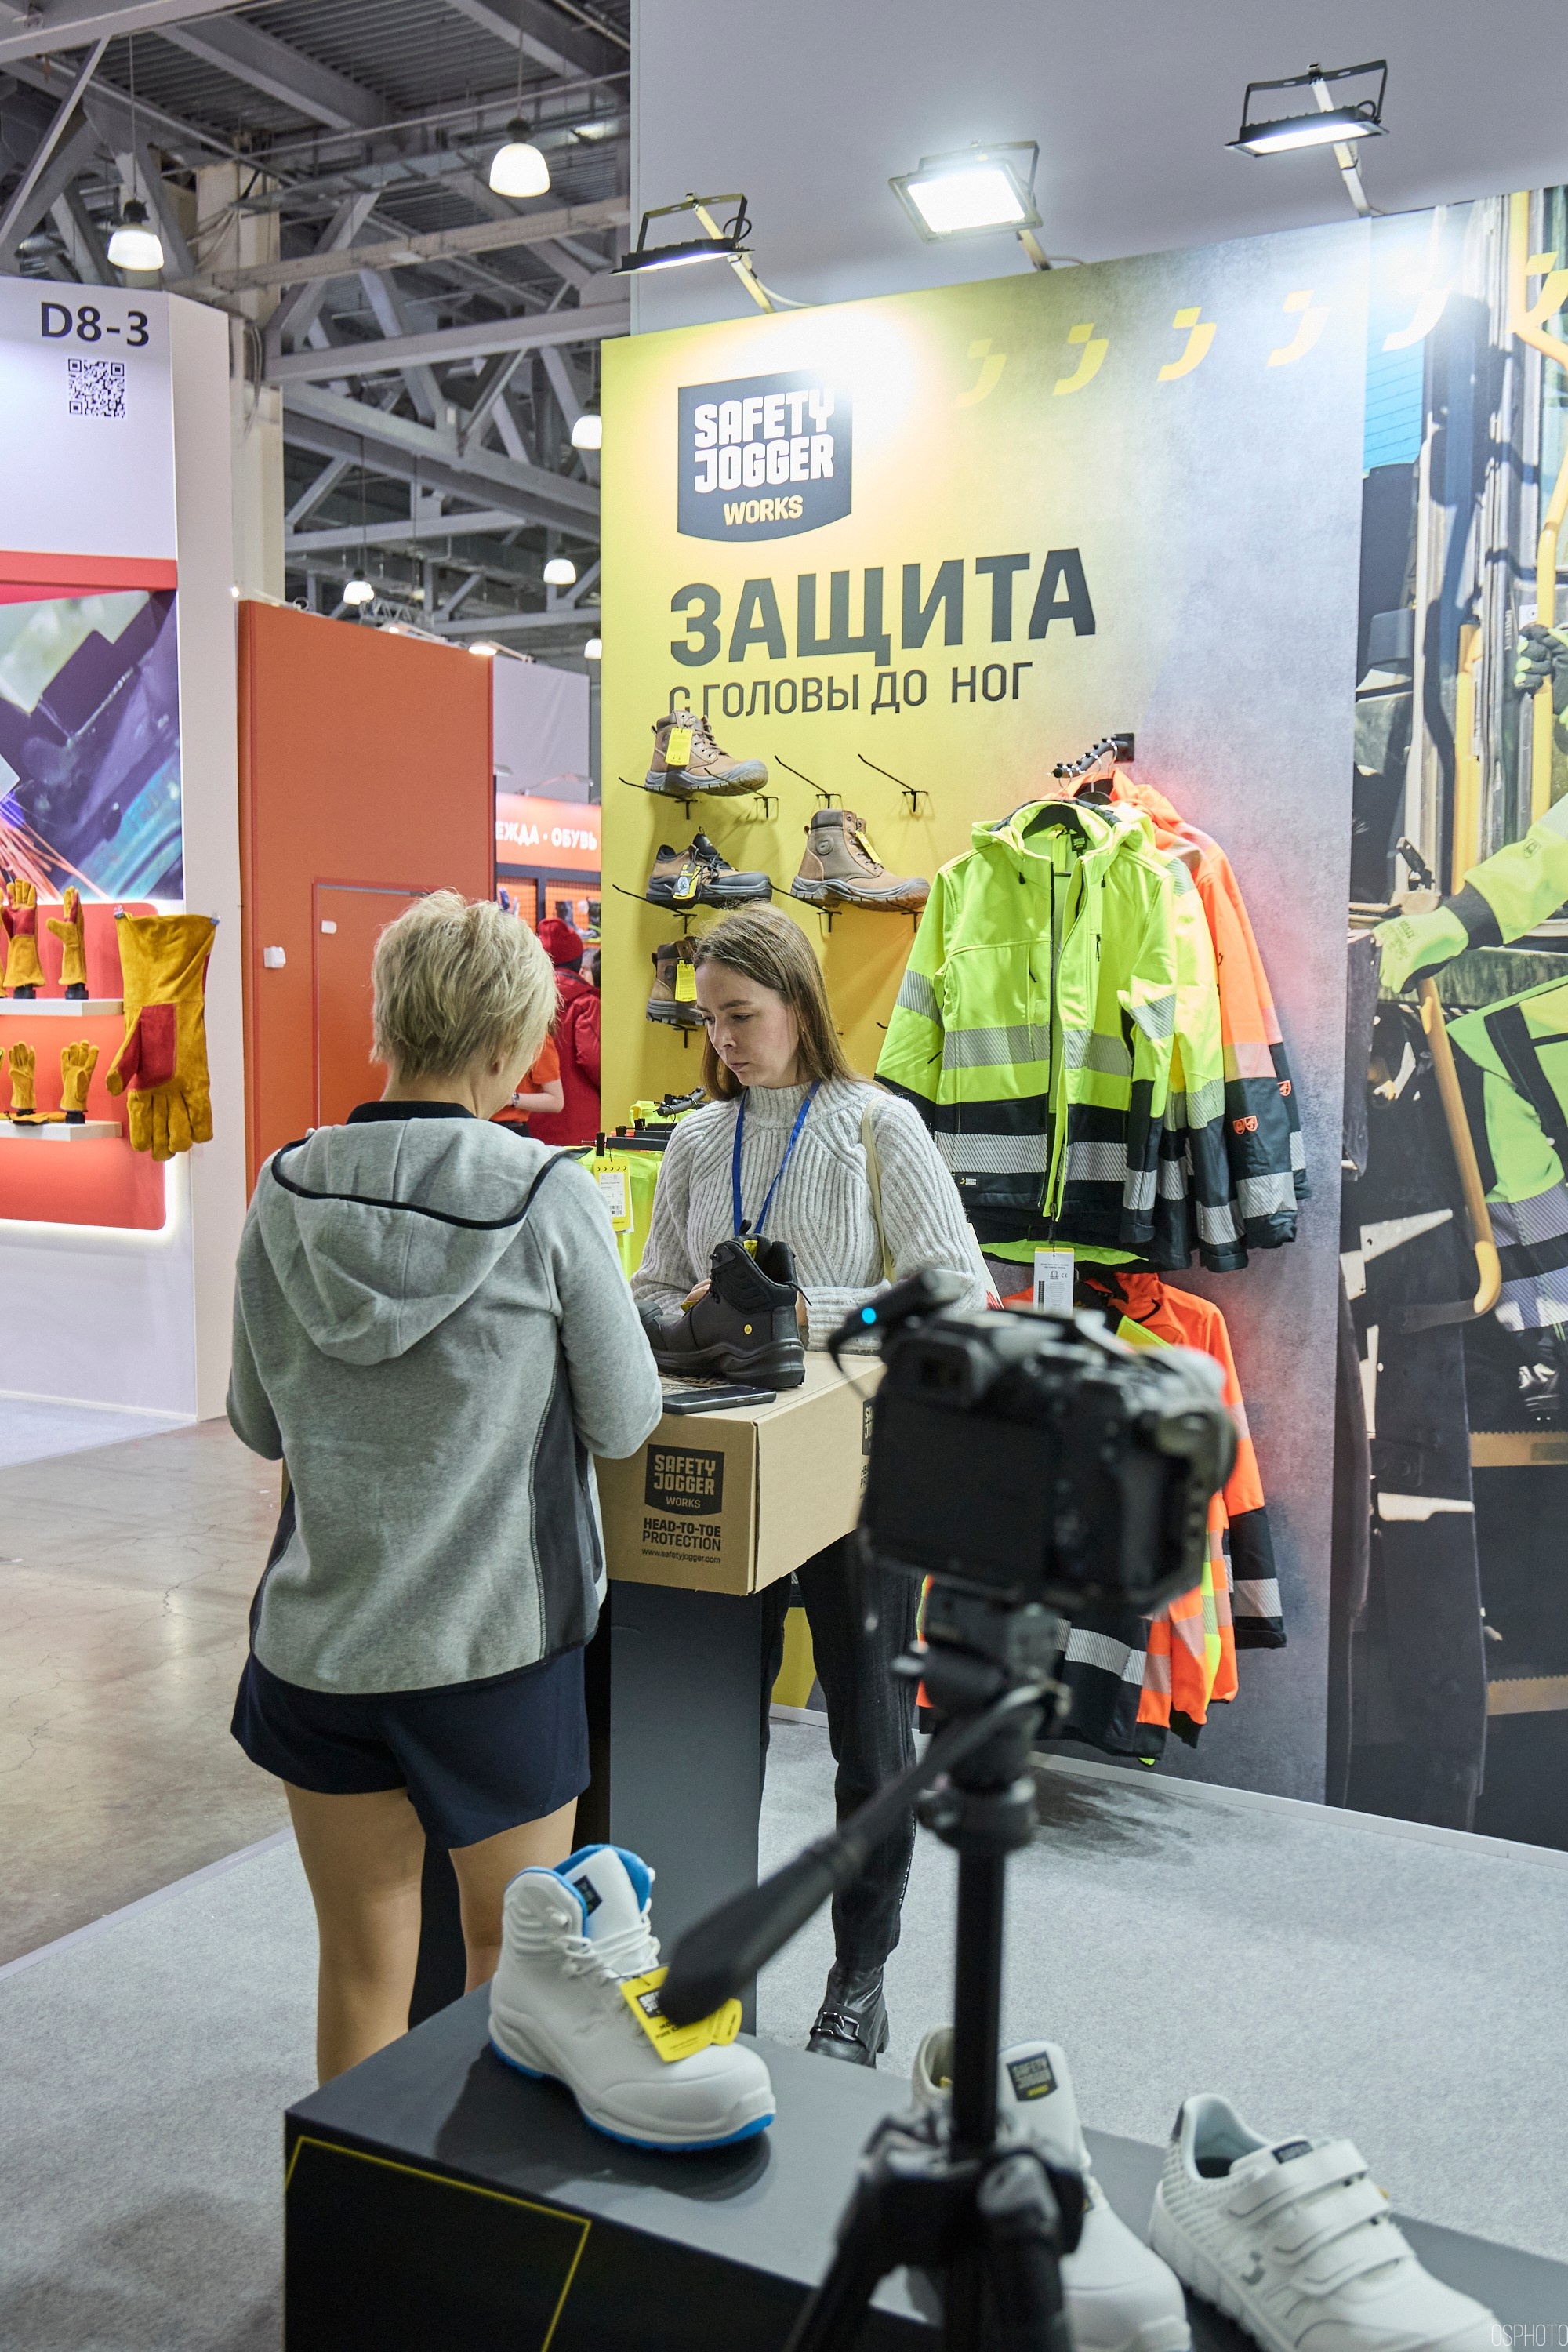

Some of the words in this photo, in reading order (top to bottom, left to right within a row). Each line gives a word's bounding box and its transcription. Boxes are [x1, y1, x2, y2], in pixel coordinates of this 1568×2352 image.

[41, 301, 149, 347] D8-3
[695, 389, 835, 448] SAFETY
[695, 434, 834, 494] JOGGER
[723, 495, 804, 526] WORKS
[670, 547, 1096, 667] ЗАЩИТА
[669, 686, 691, 713] С
[702, 673, 859, 719] ГОЛОВЫ
[870, 669, 927, 715] ДО
[951, 661, 1033, 703] НОГ
[550, 827, 597, 851] ОБУВЬ
[654, 1454, 717, 1476] SAFETY
[653, 1472, 715, 1495] JOGGER
[666, 1496, 701, 1508] WORKS
[644, 1518, 721, 1537] HEAD-TO-TOE
[642, 1530, 721, 1552] PROTECTION
[641, 1548, 720, 1564] www.safetyjogger.com
